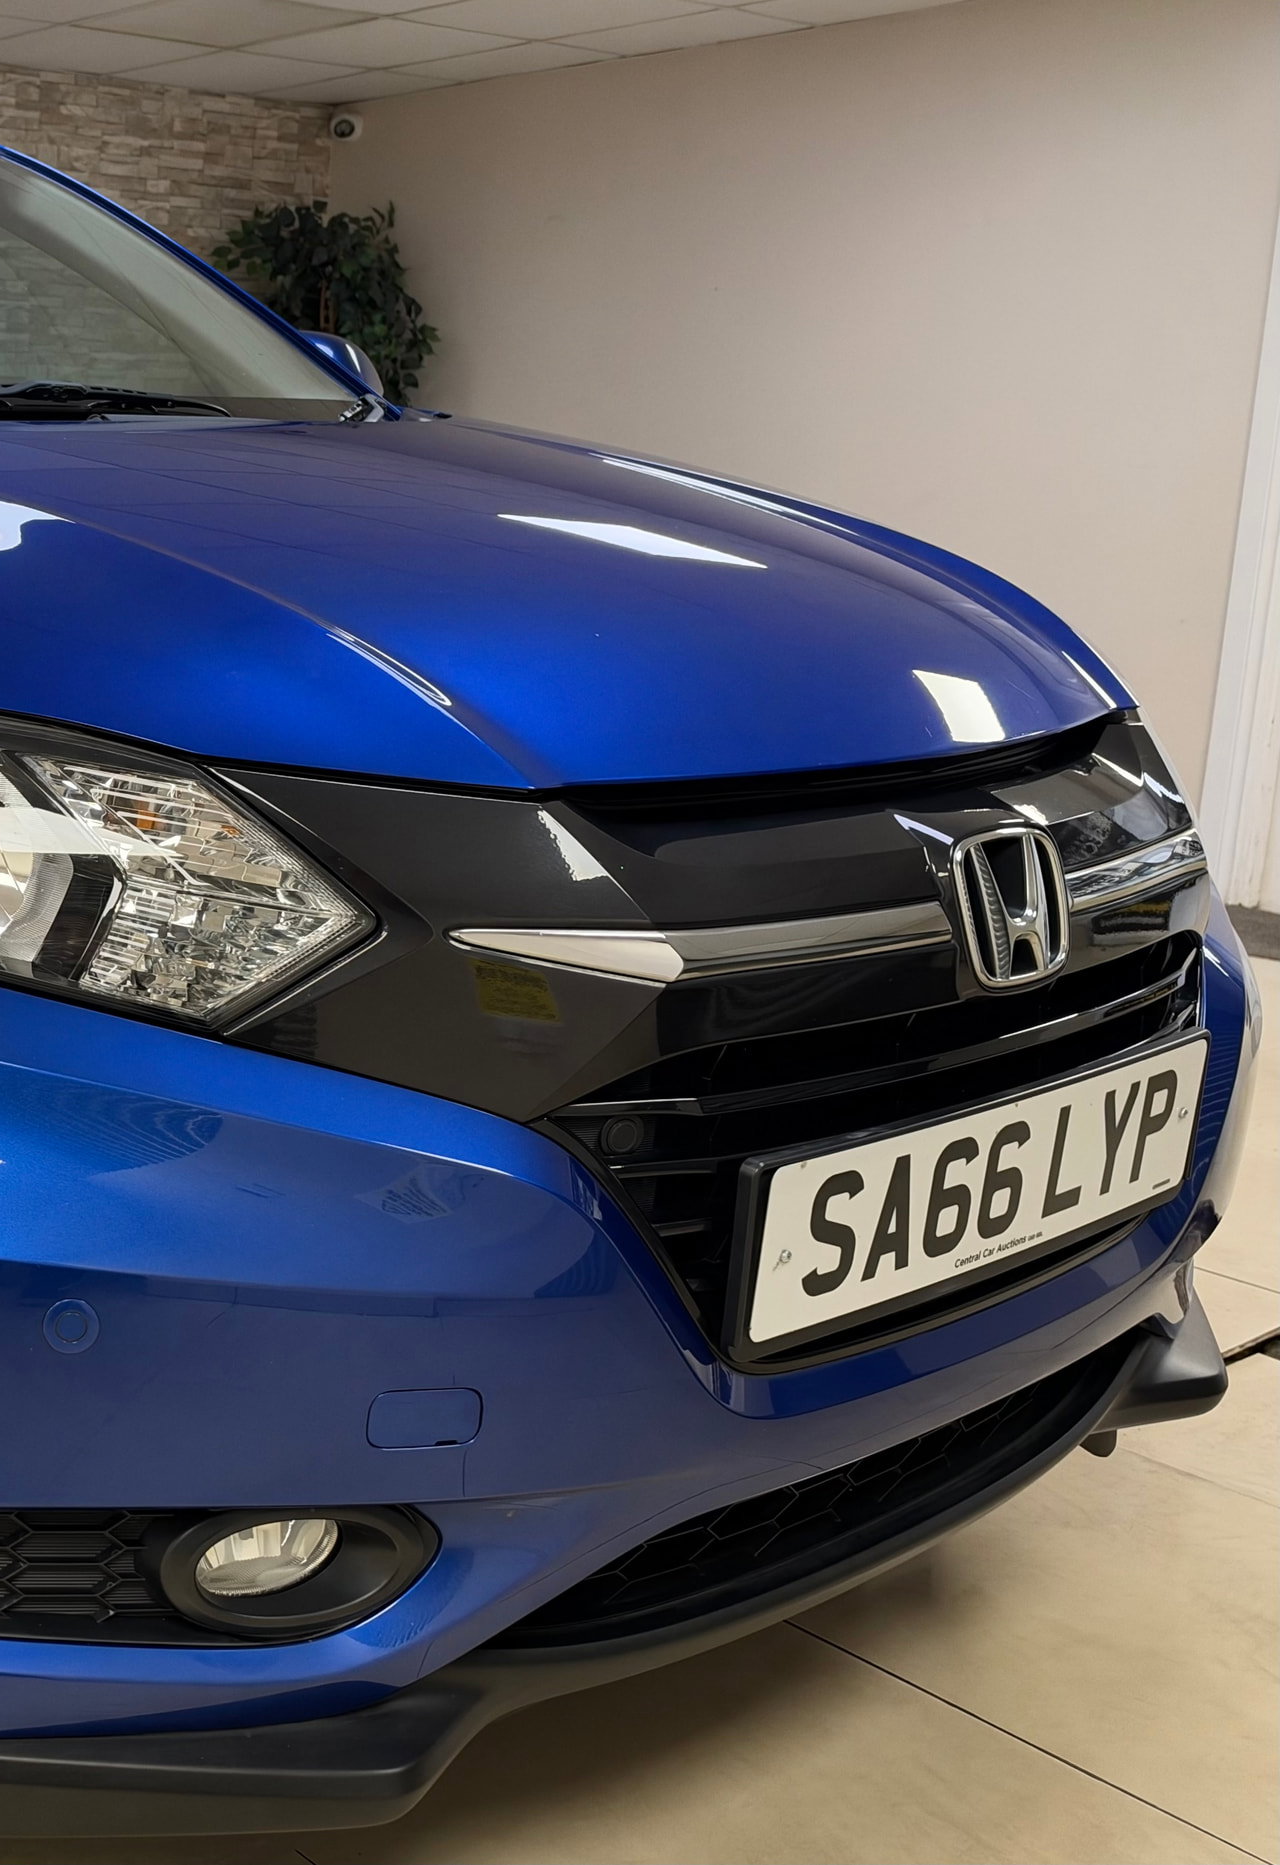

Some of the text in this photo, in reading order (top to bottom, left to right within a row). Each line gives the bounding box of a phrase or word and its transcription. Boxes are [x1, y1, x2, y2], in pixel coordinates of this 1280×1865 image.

[802, 1069, 1178, 1297] SA66 LYP
[954, 1251, 981, 1268] Central
[983, 1247, 995, 1258] Car
[996, 1236, 1027, 1252] Auctions
